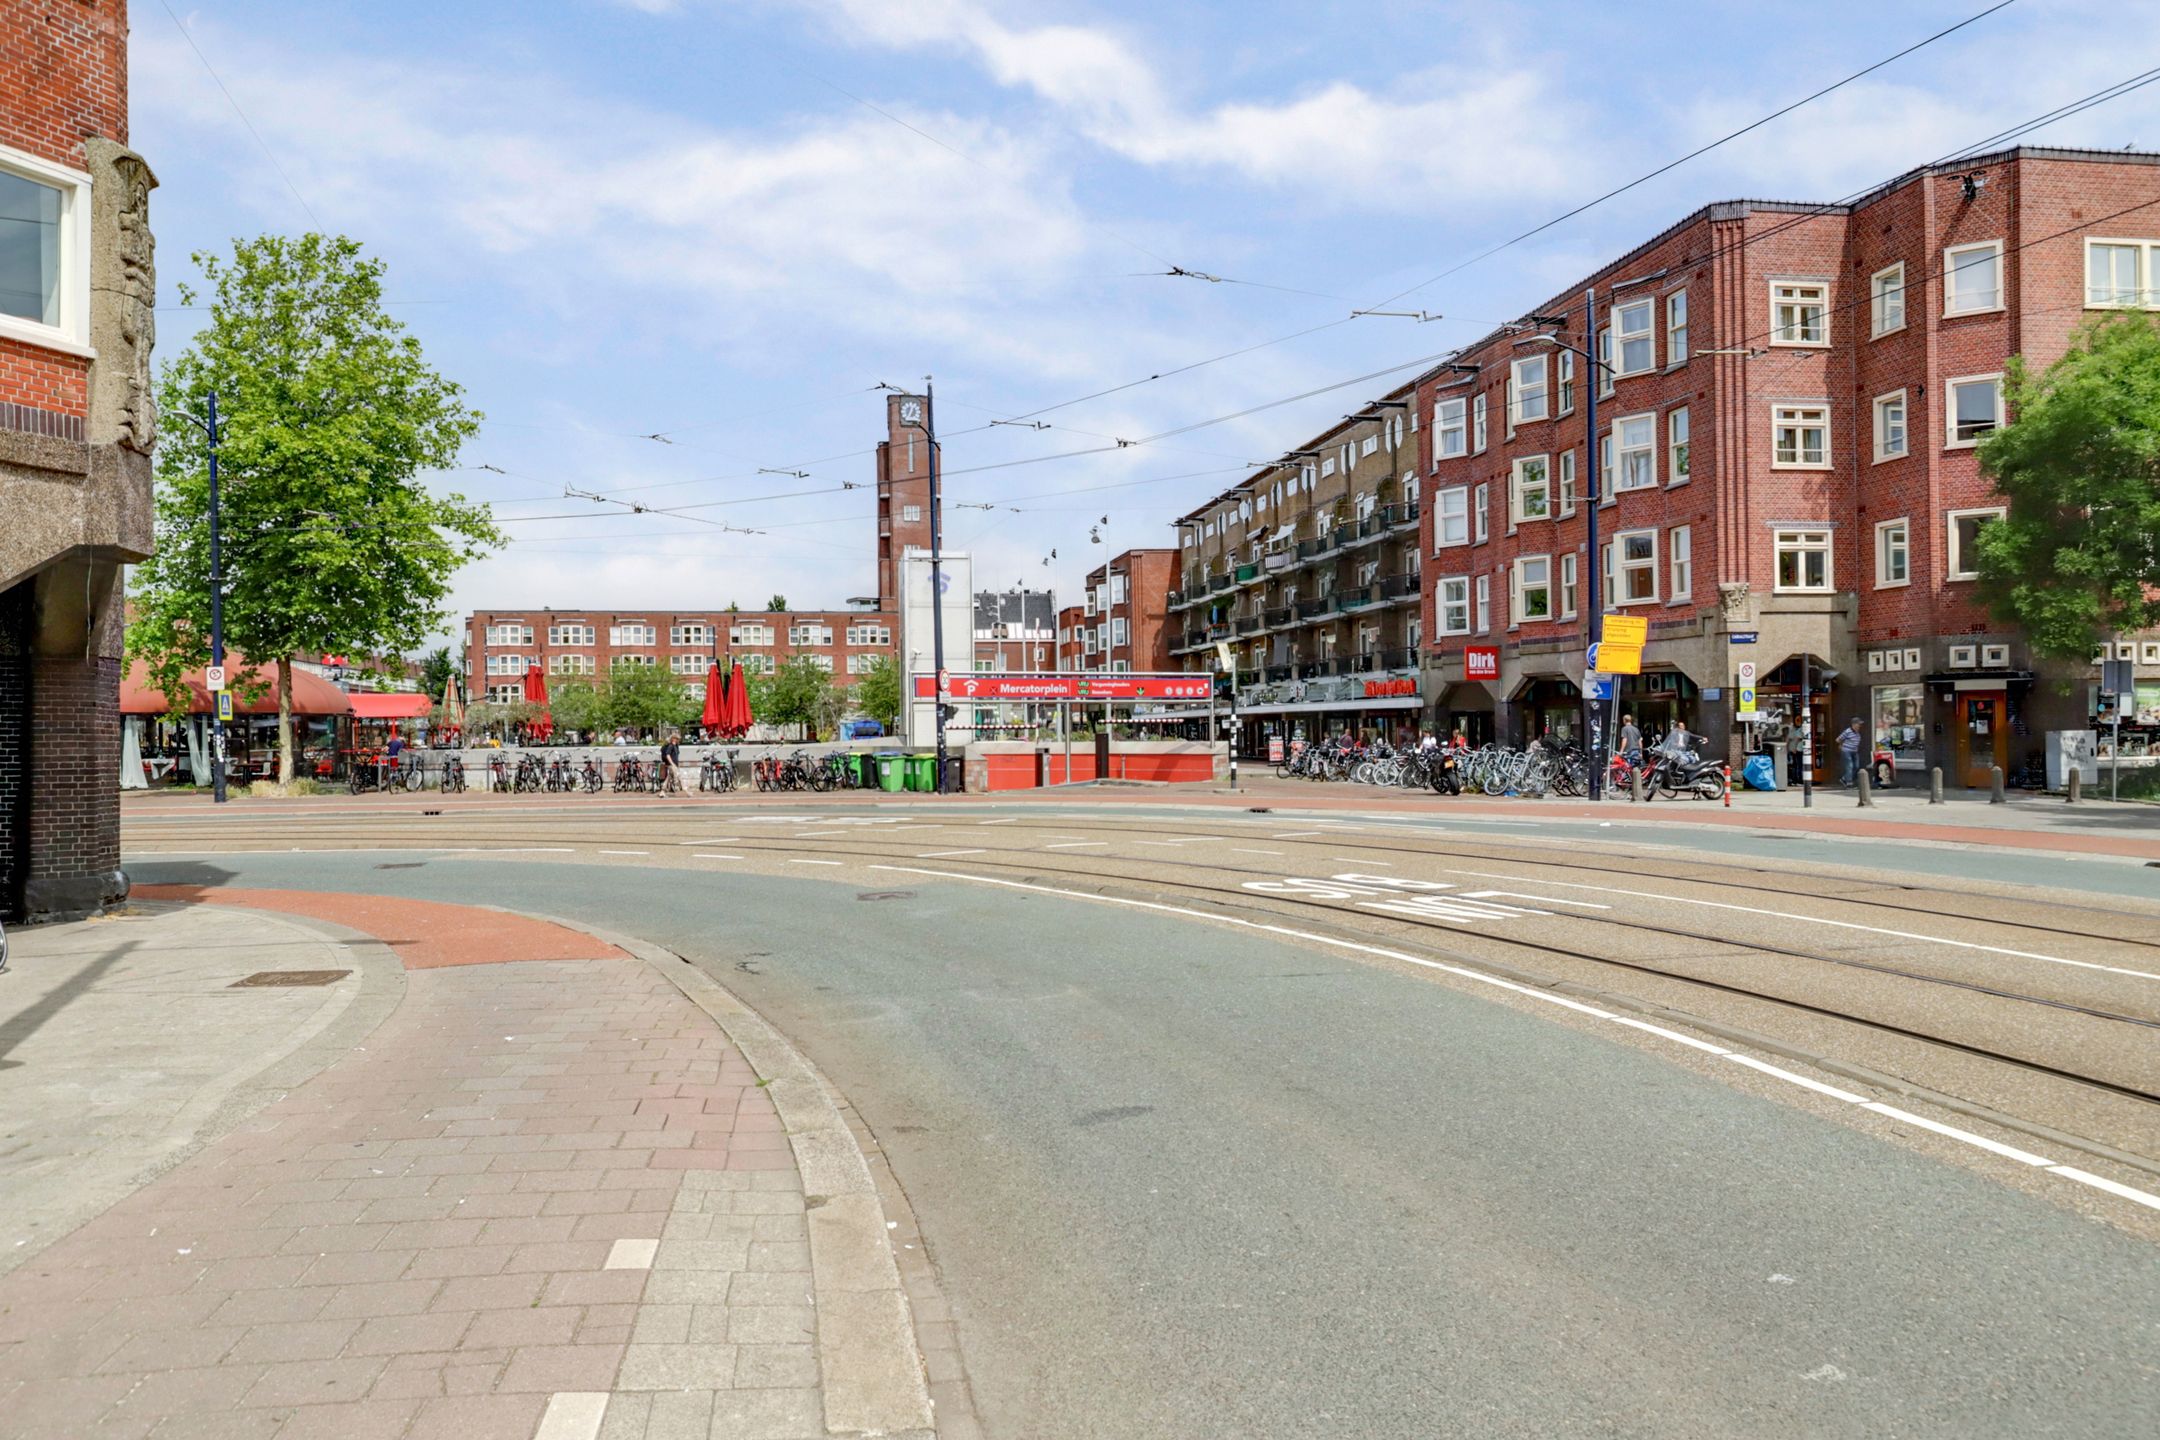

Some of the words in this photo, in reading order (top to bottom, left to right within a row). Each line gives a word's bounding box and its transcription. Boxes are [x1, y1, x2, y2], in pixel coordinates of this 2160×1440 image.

[1468, 652, 1496, 668] Dirk
[1000, 683, 1068, 695] Mercatorplein
[1241, 873, 1457, 899] BUS
